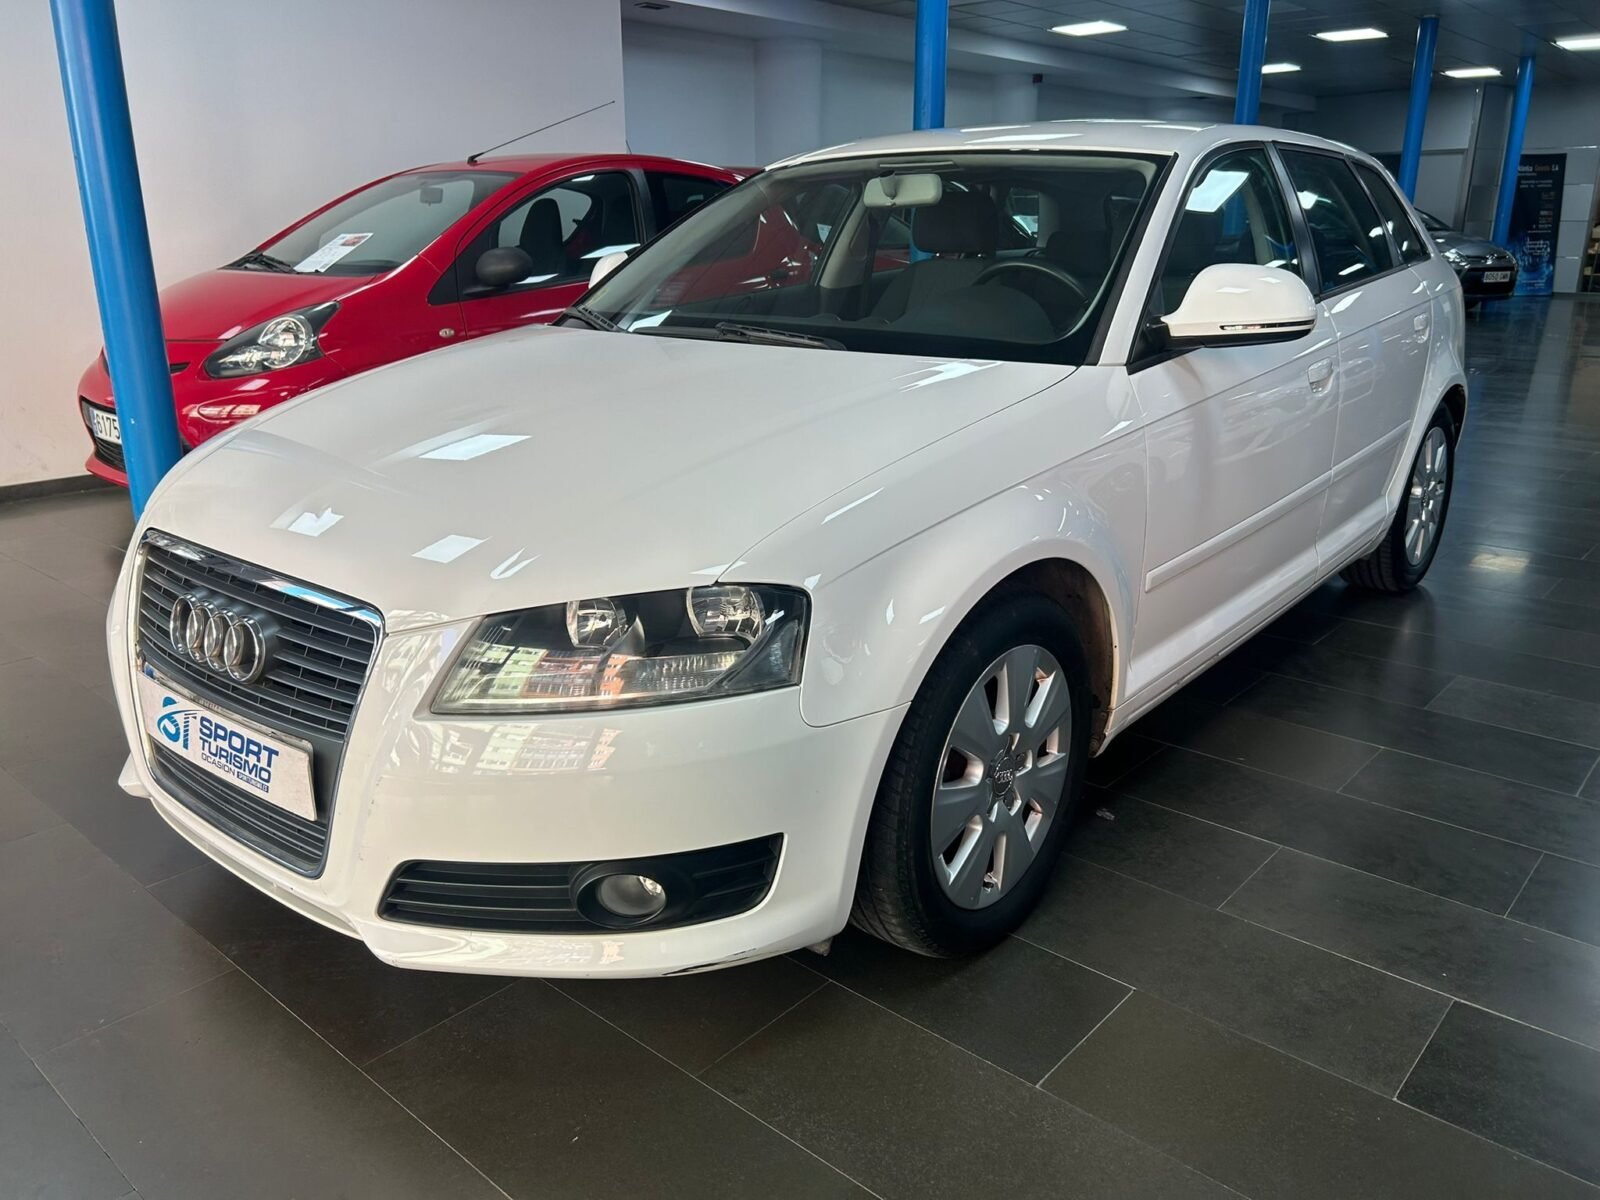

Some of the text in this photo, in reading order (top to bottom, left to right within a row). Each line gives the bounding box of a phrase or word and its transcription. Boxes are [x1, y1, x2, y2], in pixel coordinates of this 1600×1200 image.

[95, 414, 120, 440] 6175
[199, 715, 279, 769] SPORT
[199, 737, 272, 783] TURISMO
[201, 752, 236, 777] OCASION
